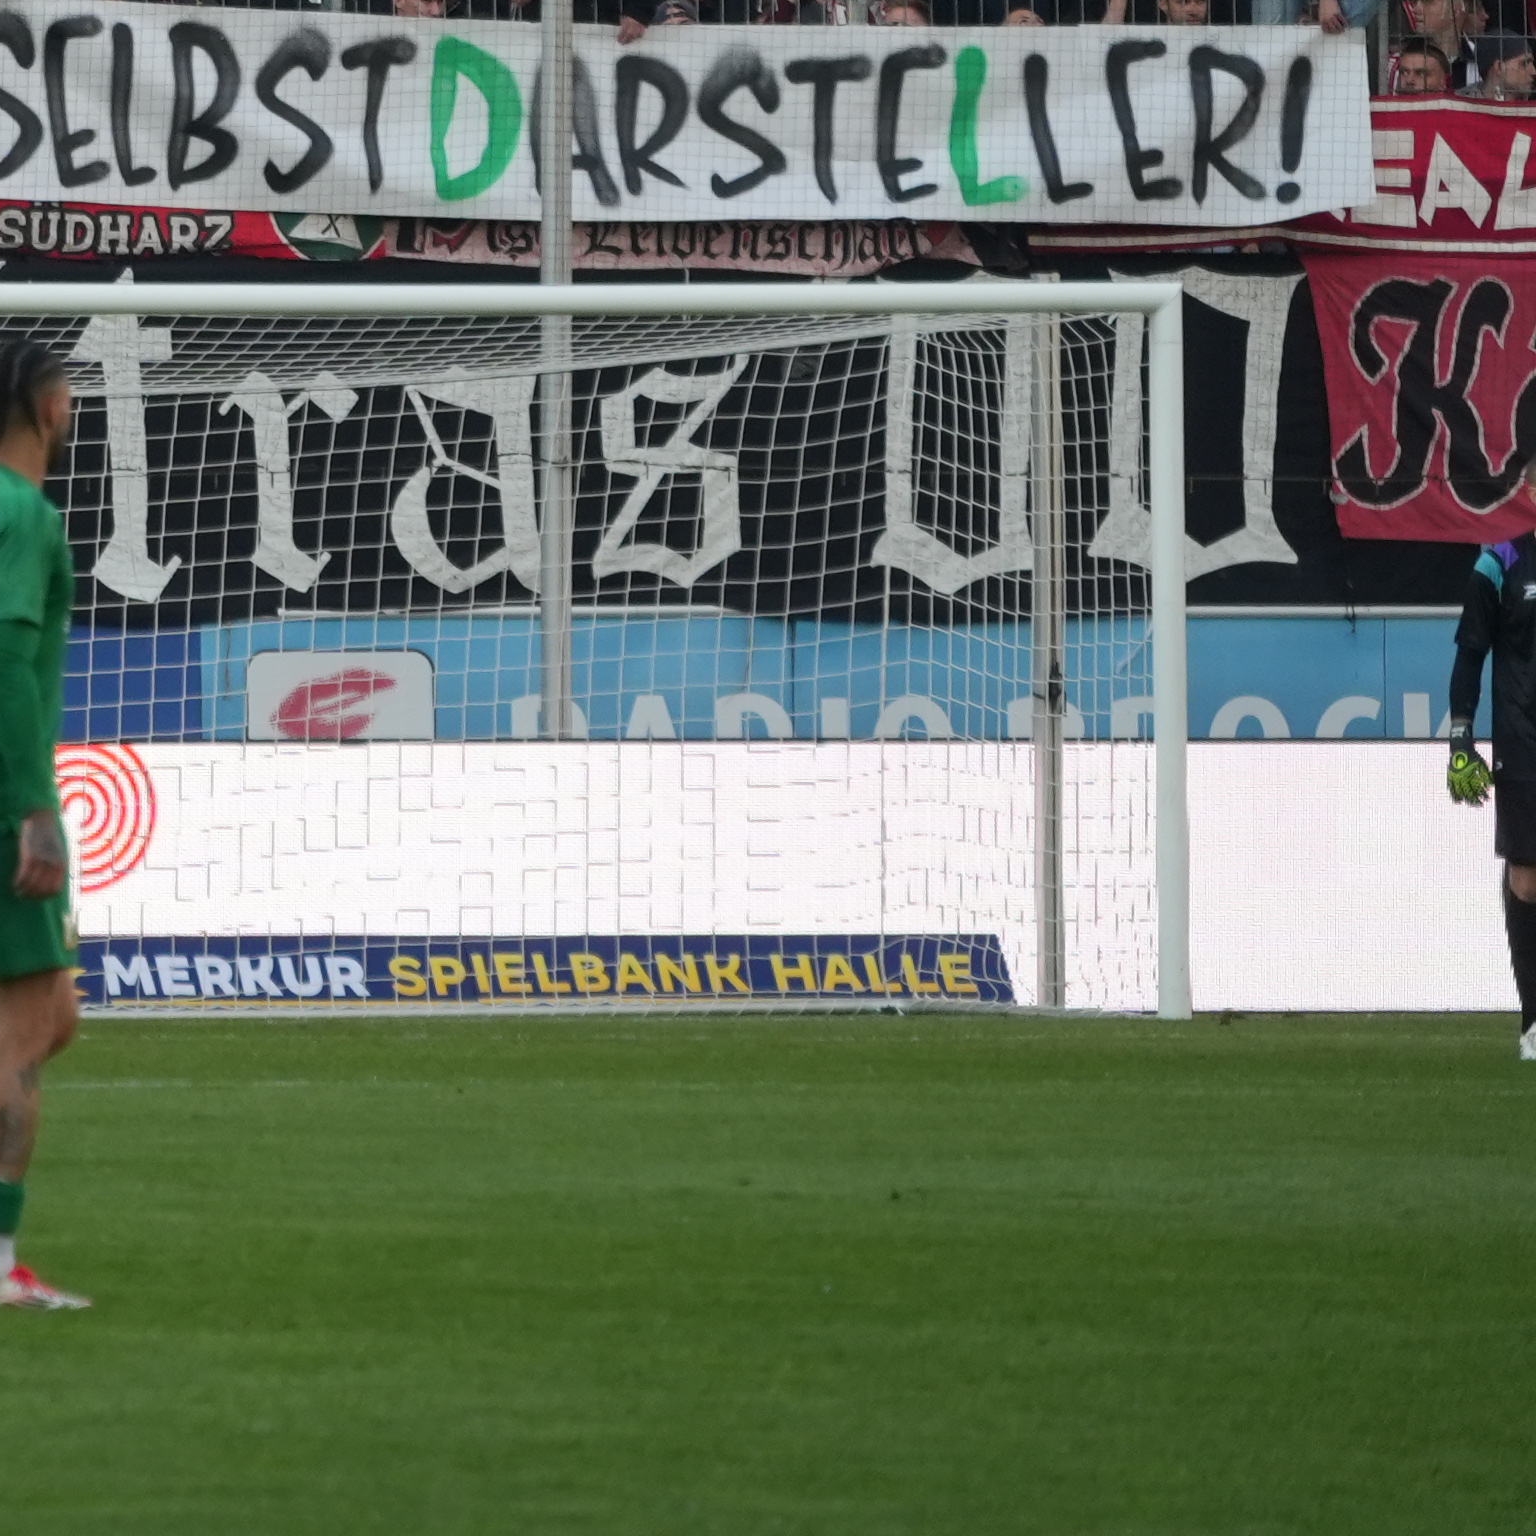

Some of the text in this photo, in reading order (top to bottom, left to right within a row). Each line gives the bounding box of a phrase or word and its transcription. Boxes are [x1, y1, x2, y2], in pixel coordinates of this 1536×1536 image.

[101, 952, 979, 999] MERKUR SPIELBANK HALLE
